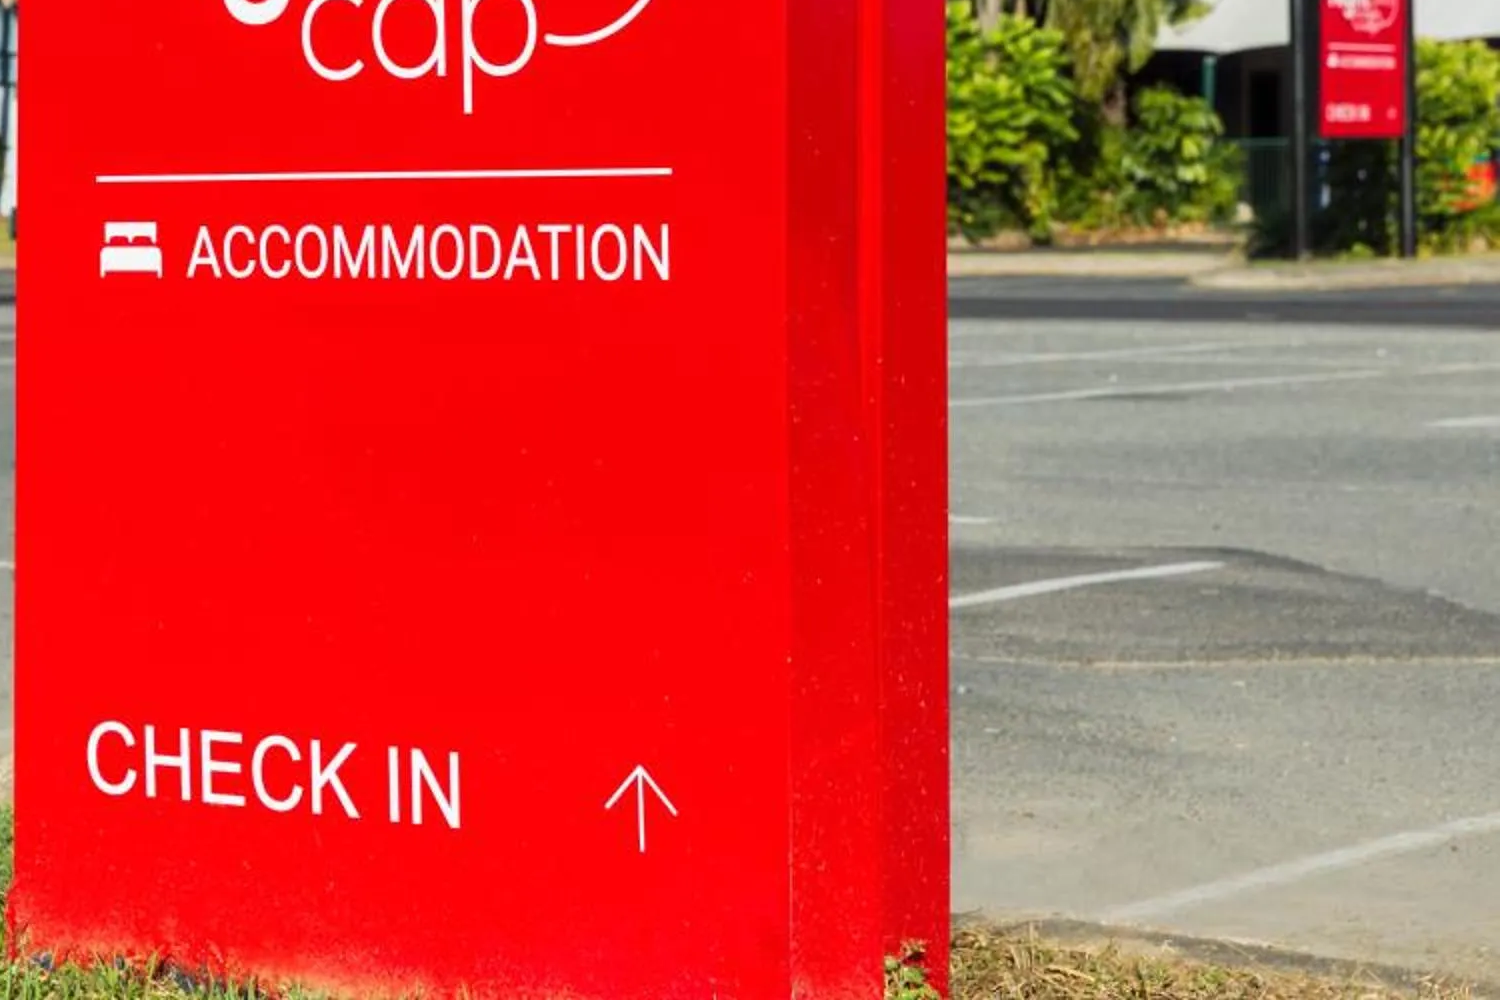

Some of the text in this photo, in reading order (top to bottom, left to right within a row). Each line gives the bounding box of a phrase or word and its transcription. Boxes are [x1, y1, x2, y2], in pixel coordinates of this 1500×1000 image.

[187, 223, 670, 281] ACCOMMODATION
[86, 720, 461, 829] CHECK IN
